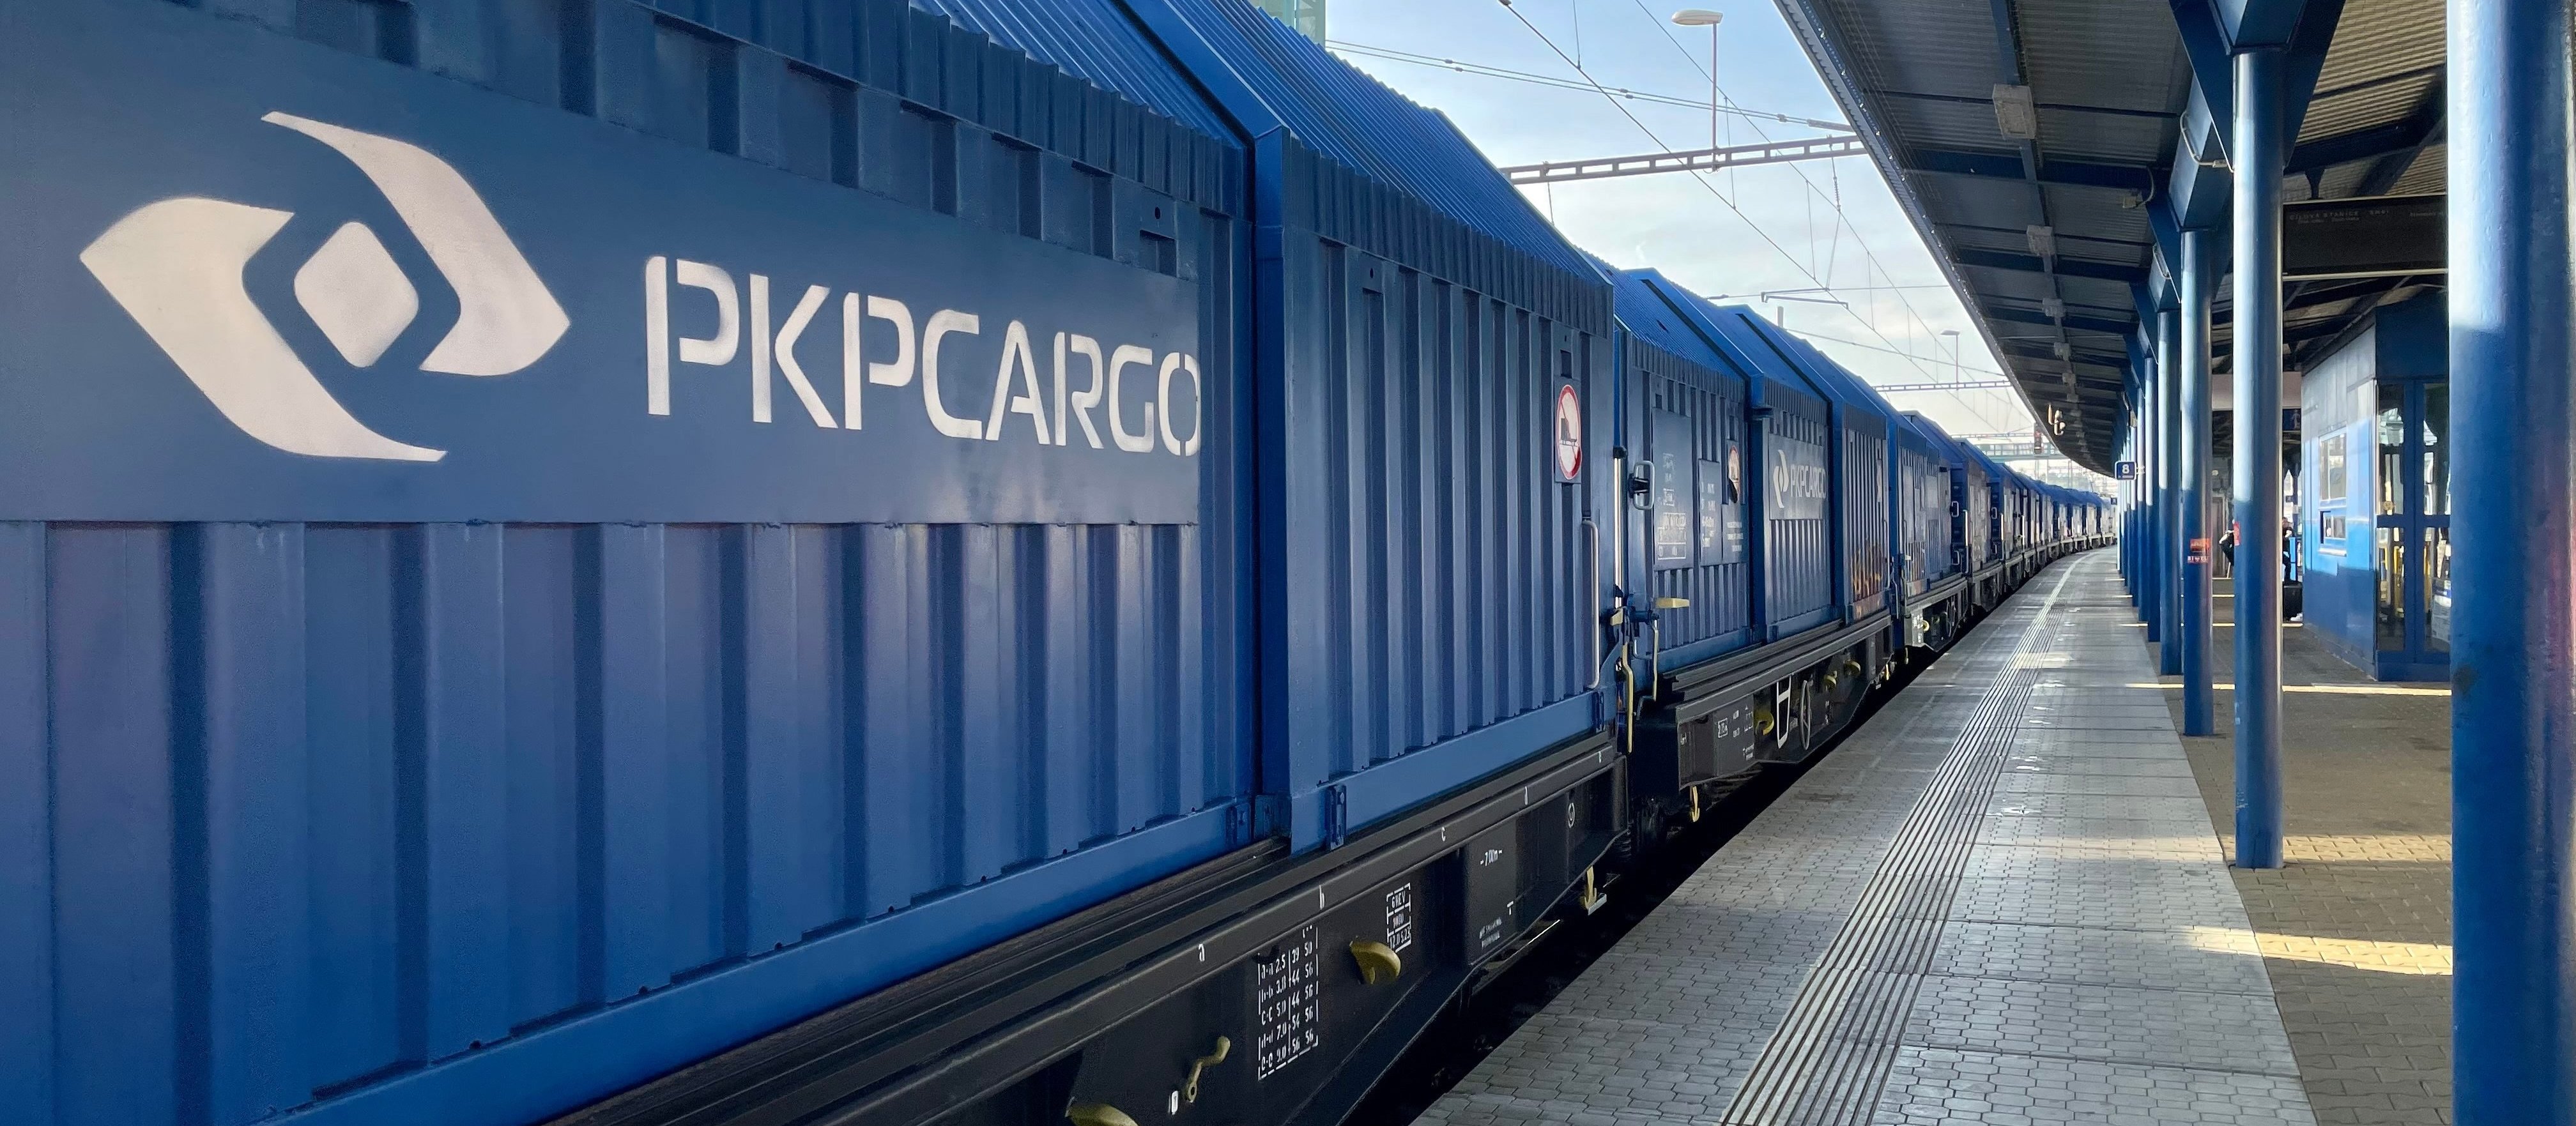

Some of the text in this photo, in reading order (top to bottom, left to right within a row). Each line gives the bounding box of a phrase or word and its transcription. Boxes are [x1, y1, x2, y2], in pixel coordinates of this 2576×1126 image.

[645, 256, 1200, 457] PKPCARGO
[2122, 464, 2130, 474] 8
[1275, 954, 1285, 973] 2.5
[1304, 941, 1313, 957] 50
[1292, 968, 1300, 985] 44
[1305, 961, 1314, 978] 56
[1305, 984, 1313, 1000] 56
[1276, 1021, 1287, 1040] 7.0
[1305, 1005, 1314, 1022] 56
[1292, 1036, 1300, 1053] 56
[1305, 1028, 1314, 1044] 56
